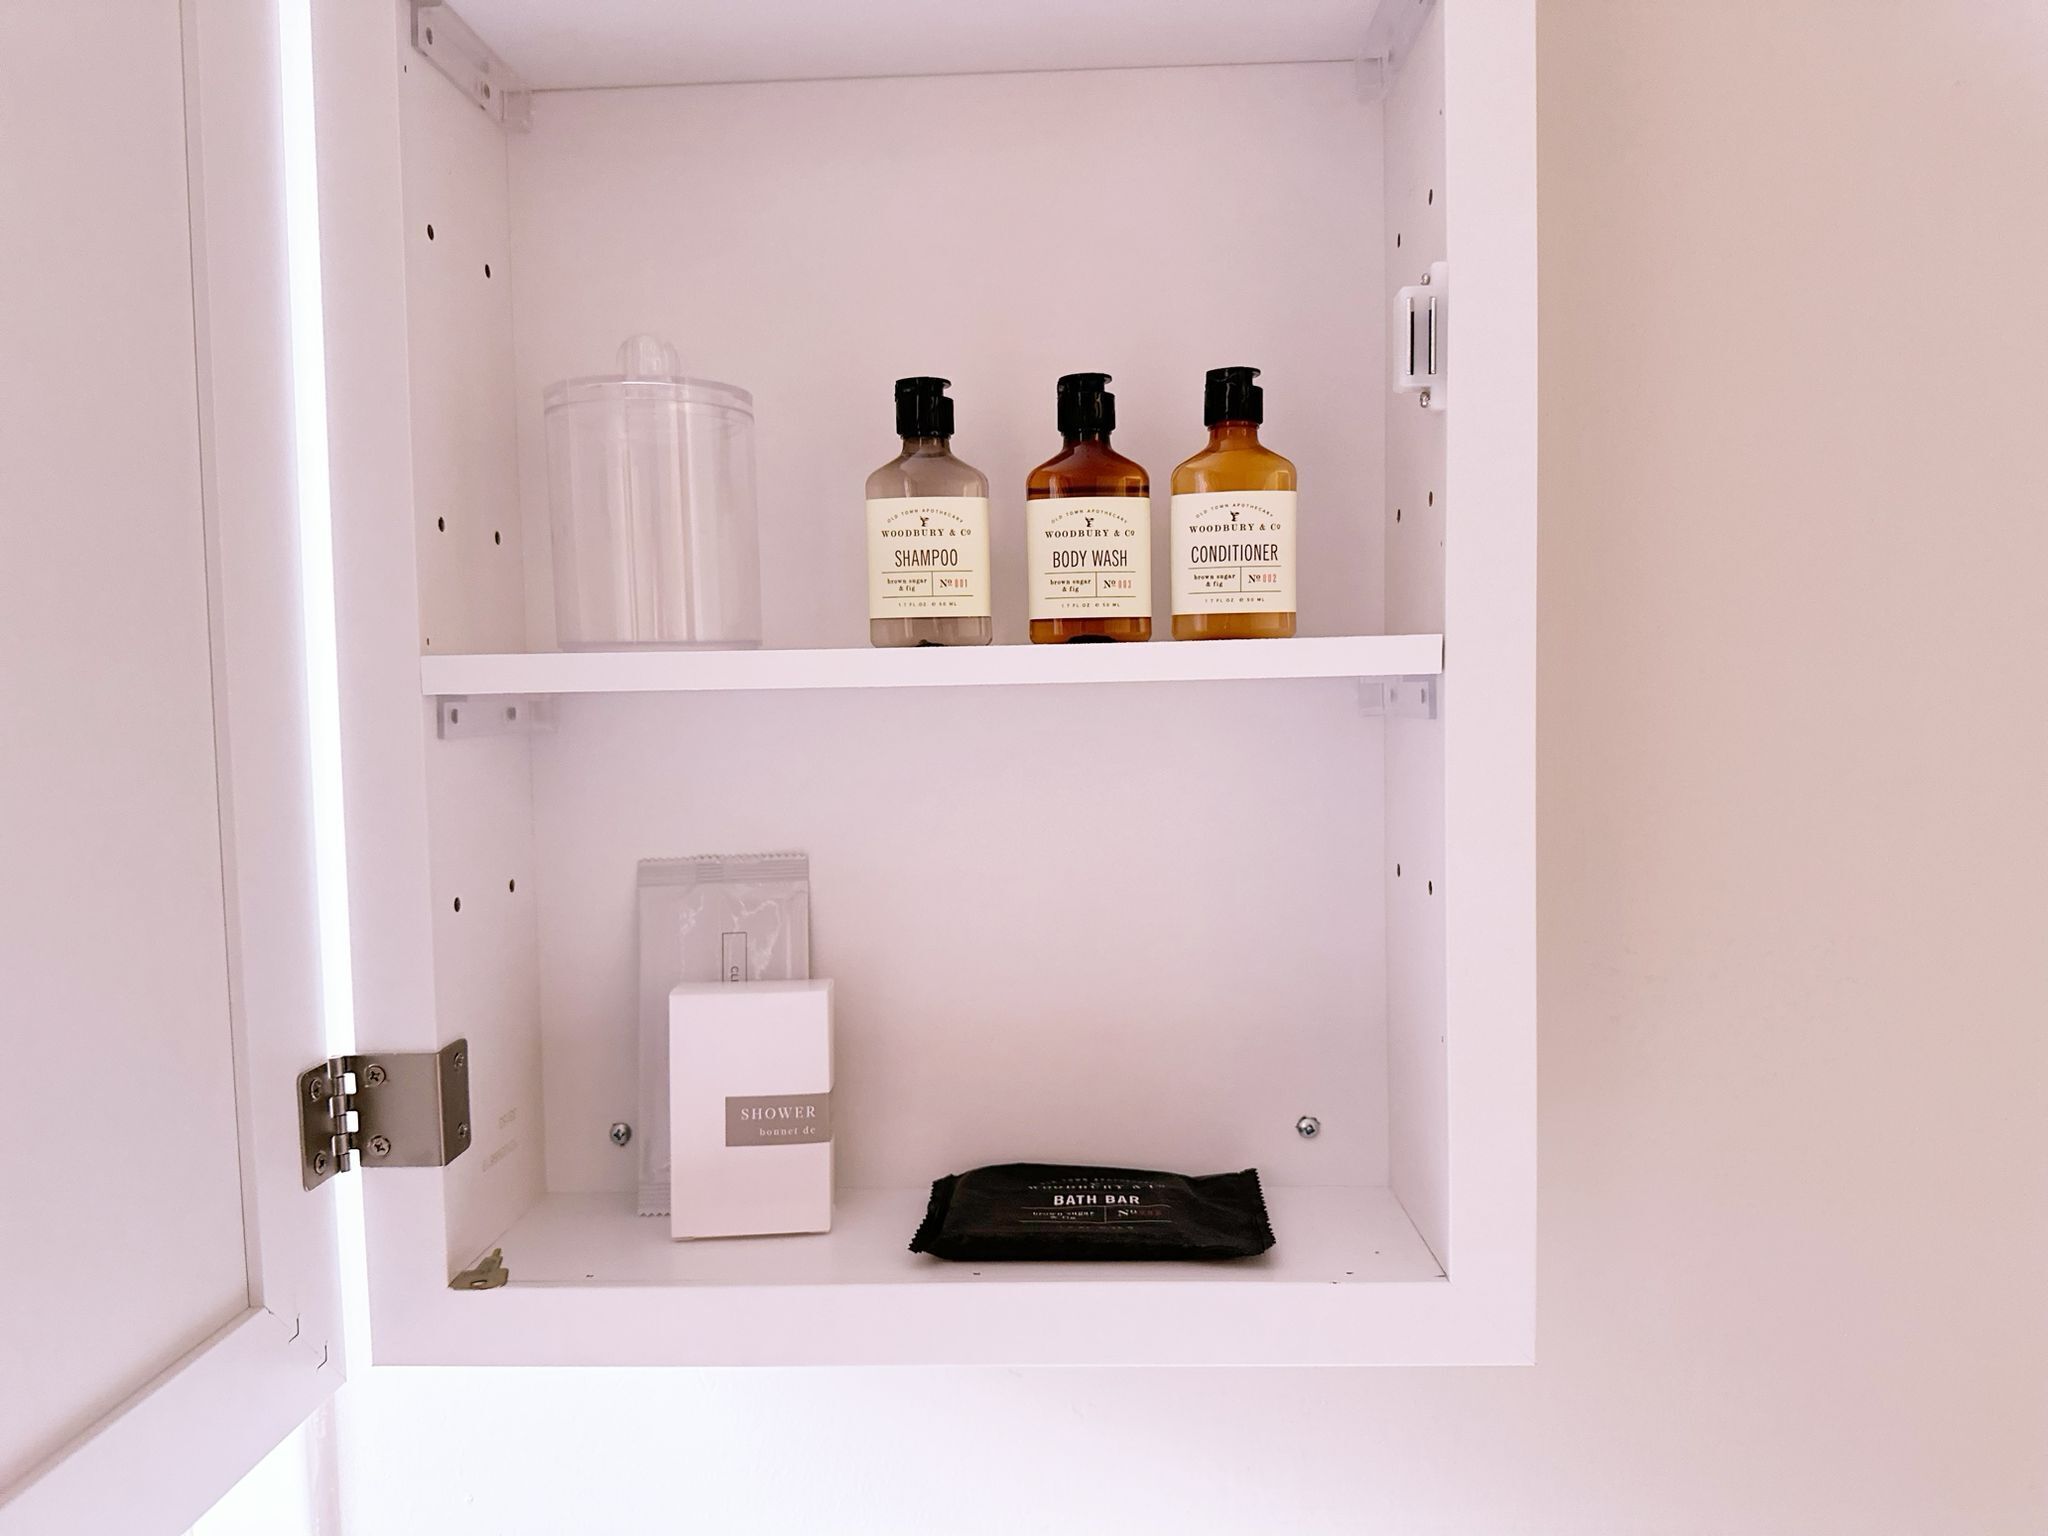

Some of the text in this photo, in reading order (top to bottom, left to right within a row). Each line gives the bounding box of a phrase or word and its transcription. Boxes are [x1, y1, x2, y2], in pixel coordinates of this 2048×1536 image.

[881, 528, 944, 538] WOODBURY
[1045, 529, 1109, 538] WOODBURY
[1189, 524, 1255, 533] WOODBURY
[895, 549, 958, 567] SHAMPOO
[1053, 549, 1127, 568] BODY WASH
[1191, 544, 1278, 563] CONDITIONER
[740, 1106, 816, 1120] SHOWER
[760, 1126, 816, 1136] bonnet de
[1054, 1194, 1140, 1206] BATH BAR
